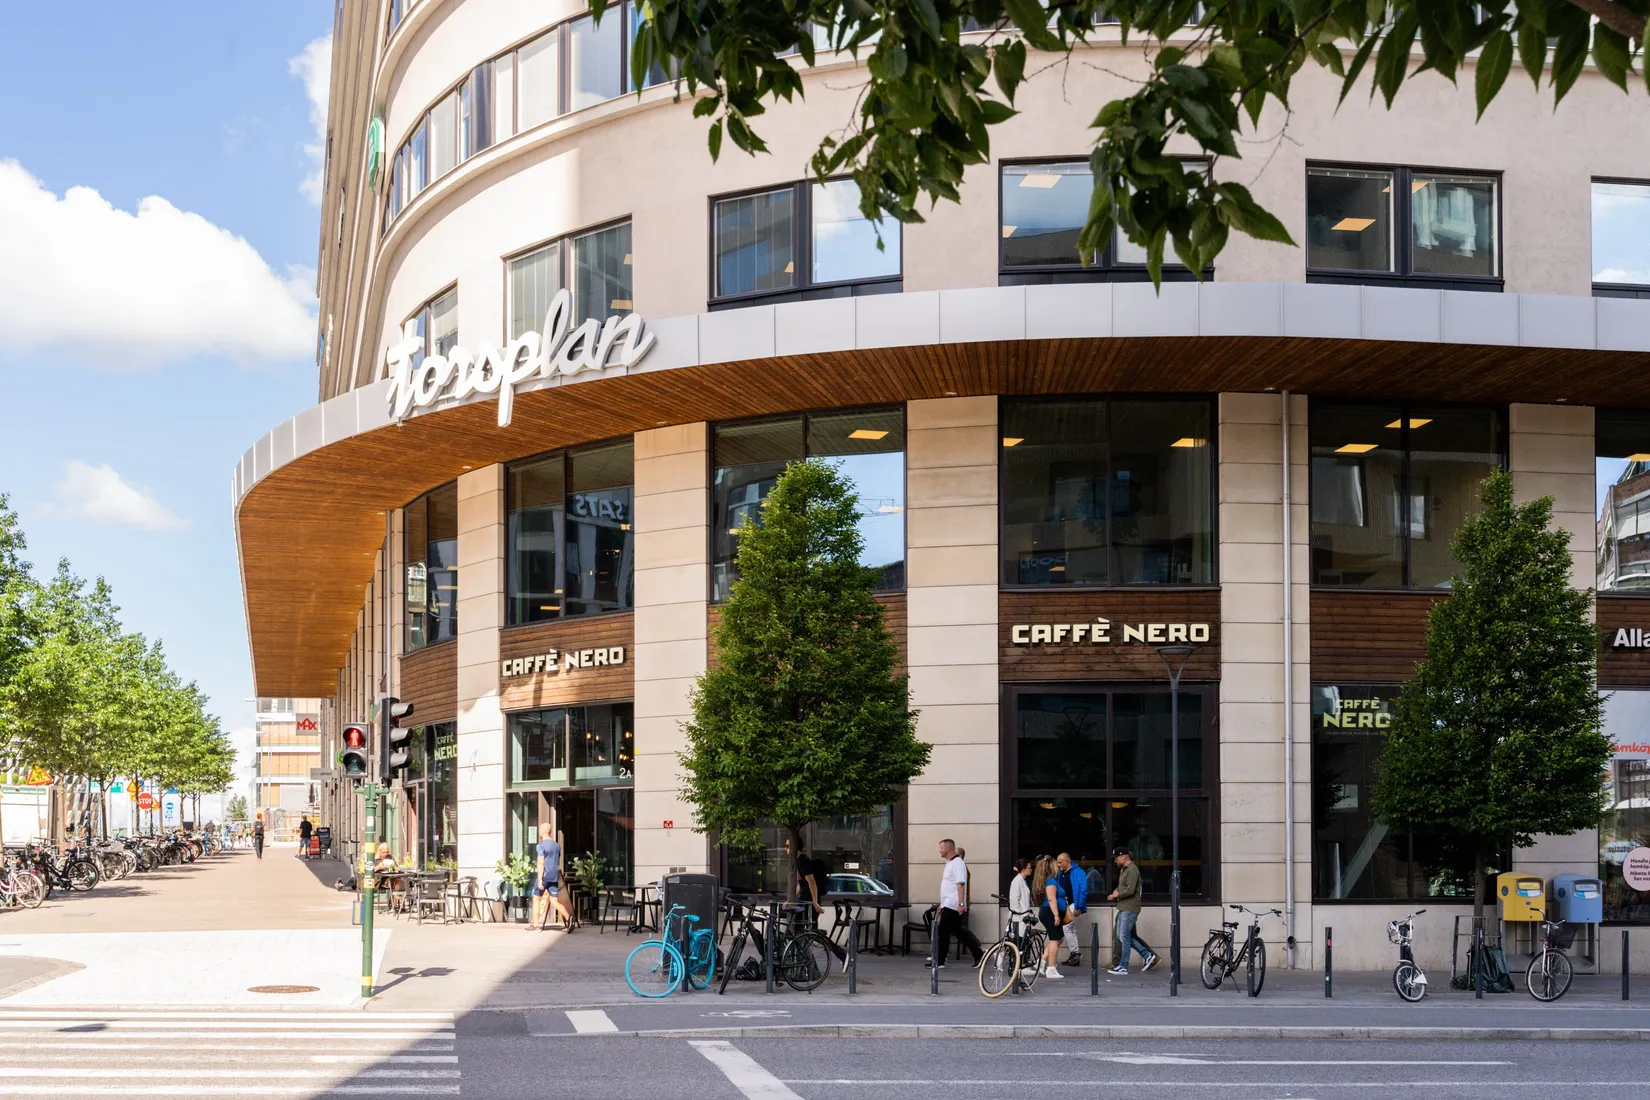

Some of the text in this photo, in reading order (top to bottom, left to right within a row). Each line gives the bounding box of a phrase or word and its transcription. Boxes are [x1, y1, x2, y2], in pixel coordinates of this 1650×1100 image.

[386, 288, 656, 427] torsplan
[1012, 617, 1209, 643] CAFFÈ NERO
[502, 646, 624, 677] CAFFÈ NERO
[1335, 696, 1380, 709] CAFFÈ
[297, 717, 317, 731] MAX
[1323, 712, 1391, 728] NERO
[619, 767, 632, 779] 2A
